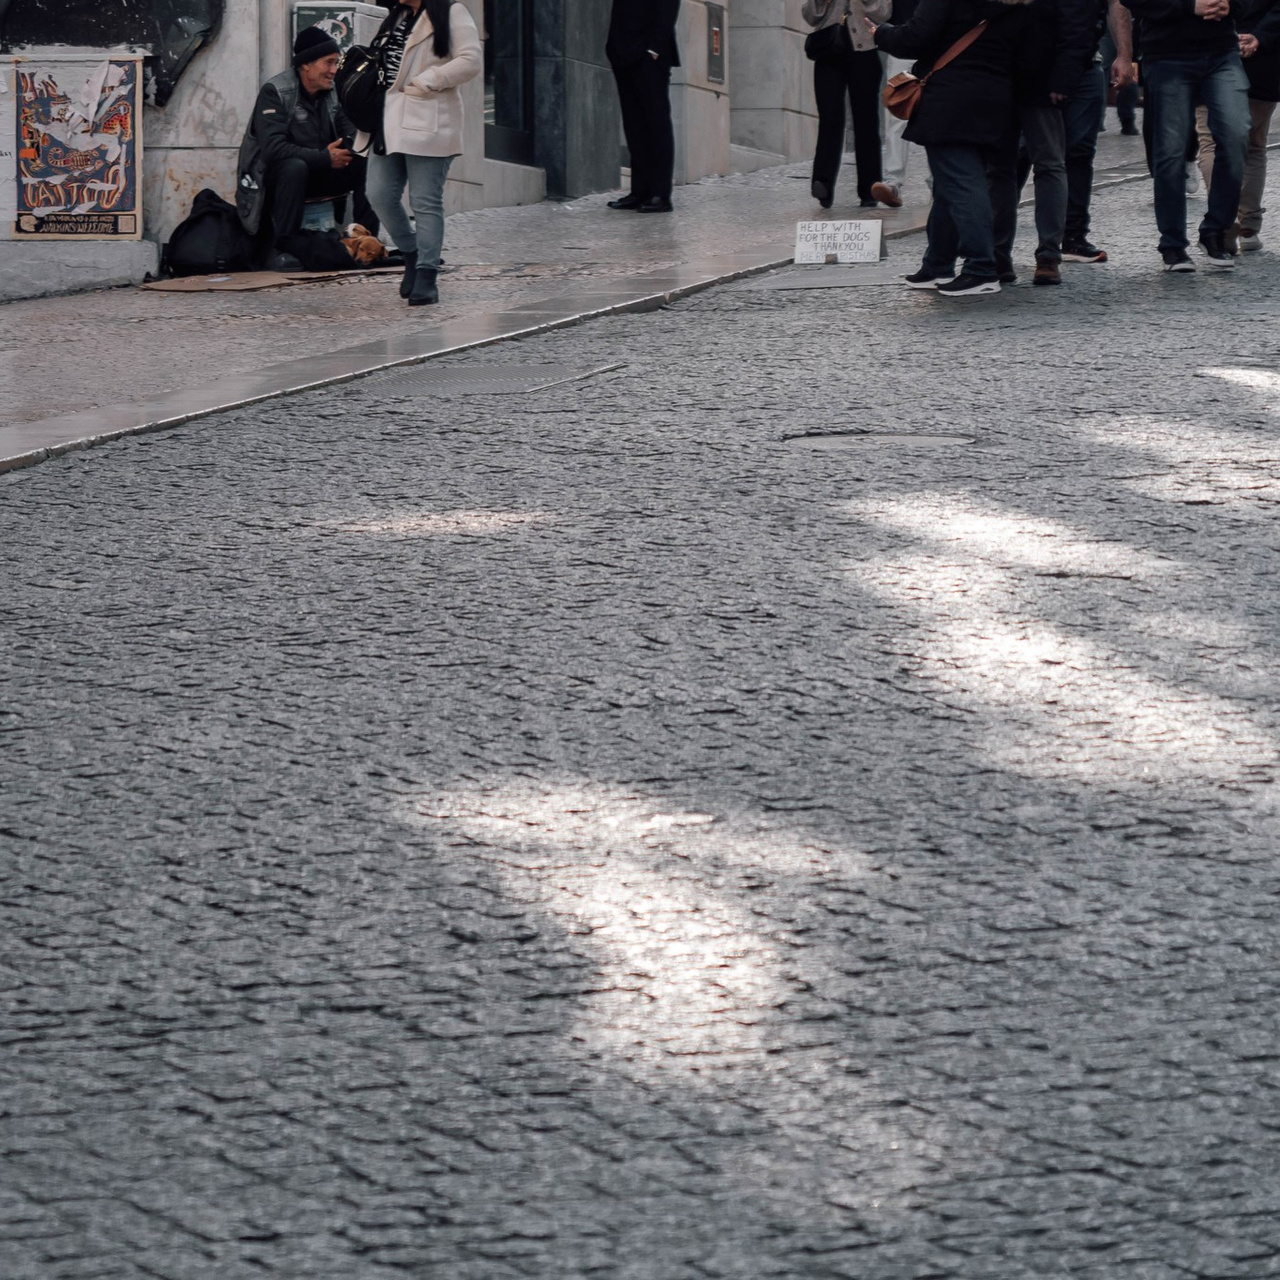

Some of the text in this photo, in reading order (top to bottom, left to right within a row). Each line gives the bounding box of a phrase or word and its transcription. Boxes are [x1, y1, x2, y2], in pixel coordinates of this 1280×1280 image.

[800, 222, 862, 232] HELP WITH
[799, 232, 871, 242] FOR THE DOGS
